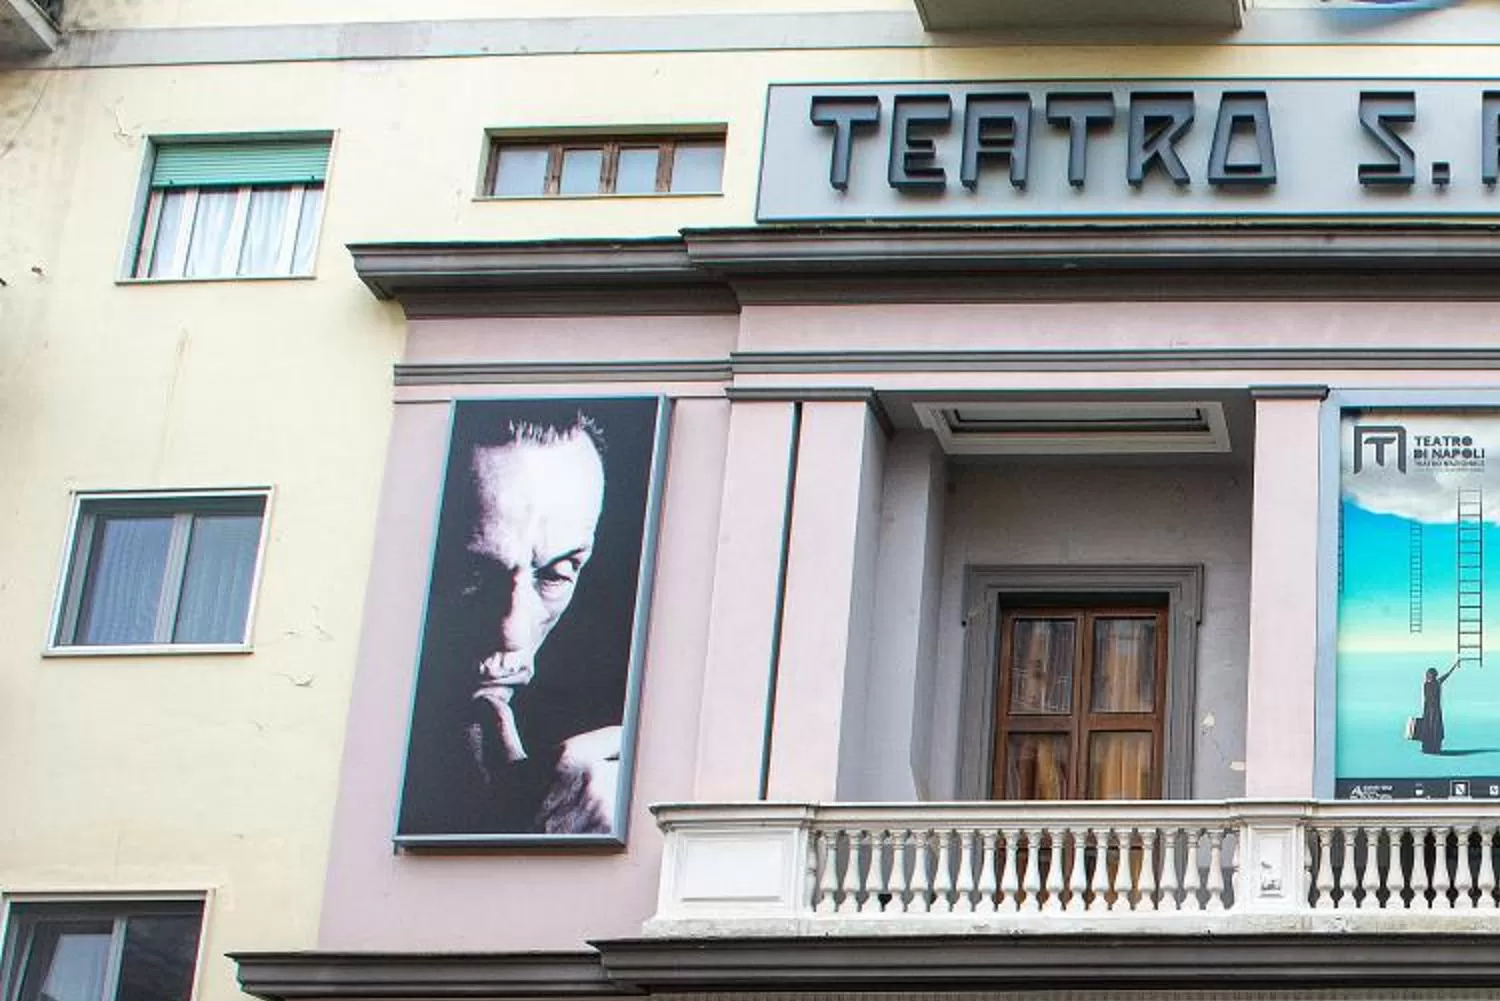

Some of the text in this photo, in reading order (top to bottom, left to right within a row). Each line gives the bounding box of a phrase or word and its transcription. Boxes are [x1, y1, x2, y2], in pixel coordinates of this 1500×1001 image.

[810, 91, 1277, 189] TEATRO
[1358, 91, 1450, 186] S.
[1414, 435, 1473, 446] TEATRO
[1414, 448, 1485, 459] DI NAPOLI
